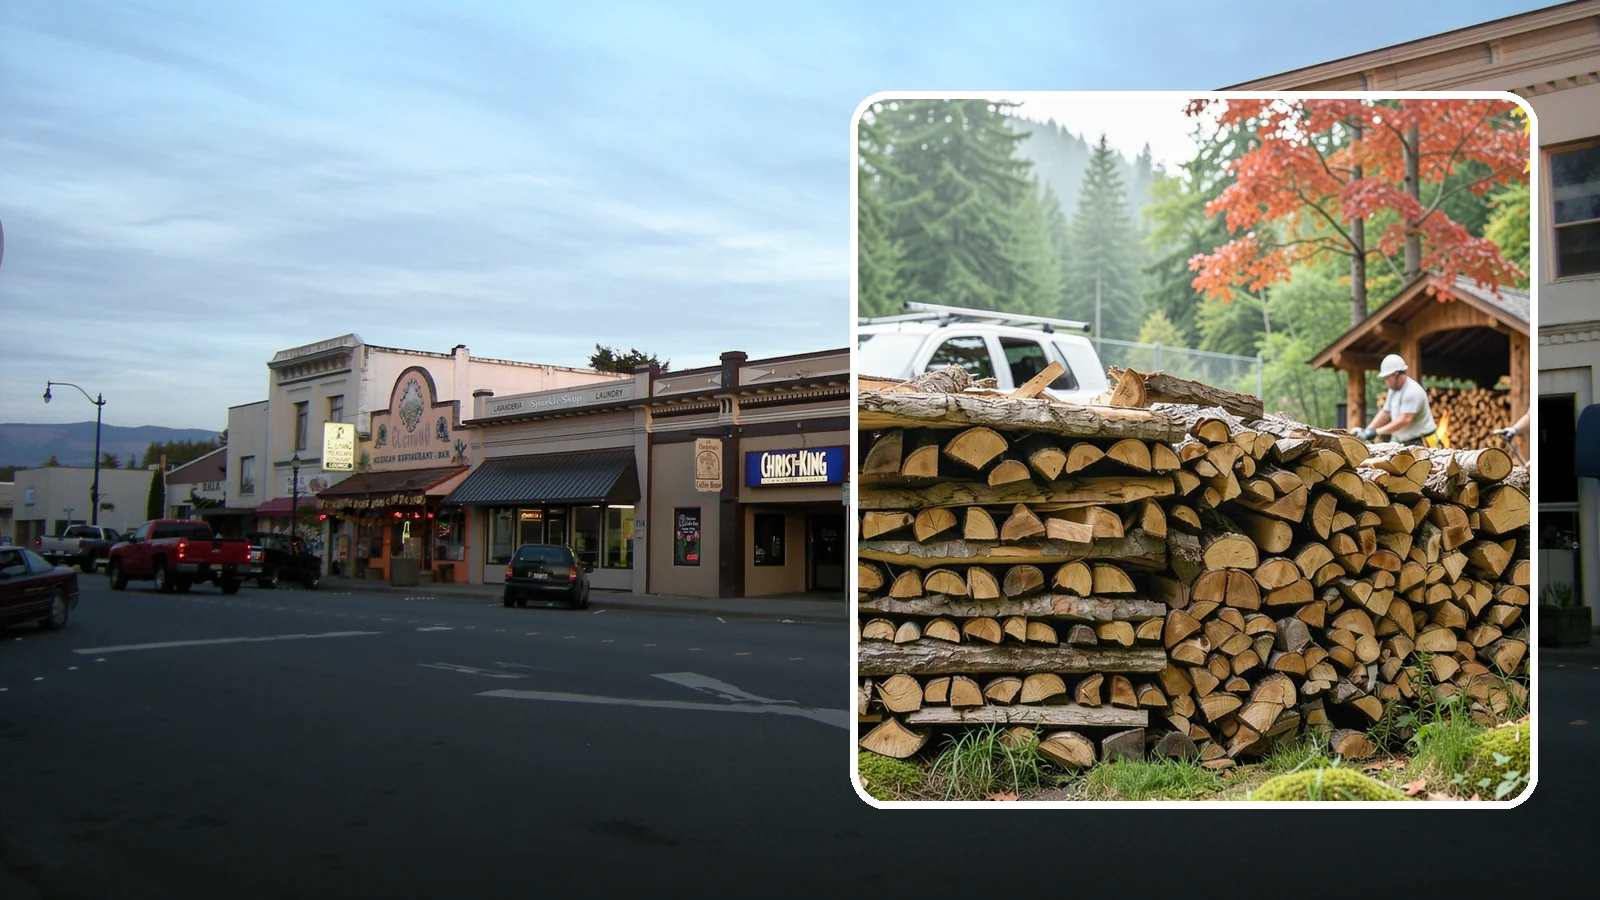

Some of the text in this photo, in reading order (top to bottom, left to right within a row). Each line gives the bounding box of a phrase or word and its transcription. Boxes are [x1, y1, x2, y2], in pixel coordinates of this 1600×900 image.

[530, 394, 582, 409] Sparkle Shop
[595, 389, 624, 400] LAUNDRY
[493, 402, 522, 413] LAVANDERIA
[392, 425, 401, 449] EL
[373, 455, 396, 464] MEXICAN
[397, 451, 433, 462] RESTAURANT
[437, 450, 450, 459] BAR
[760, 450, 827, 478] CHRIST KING
